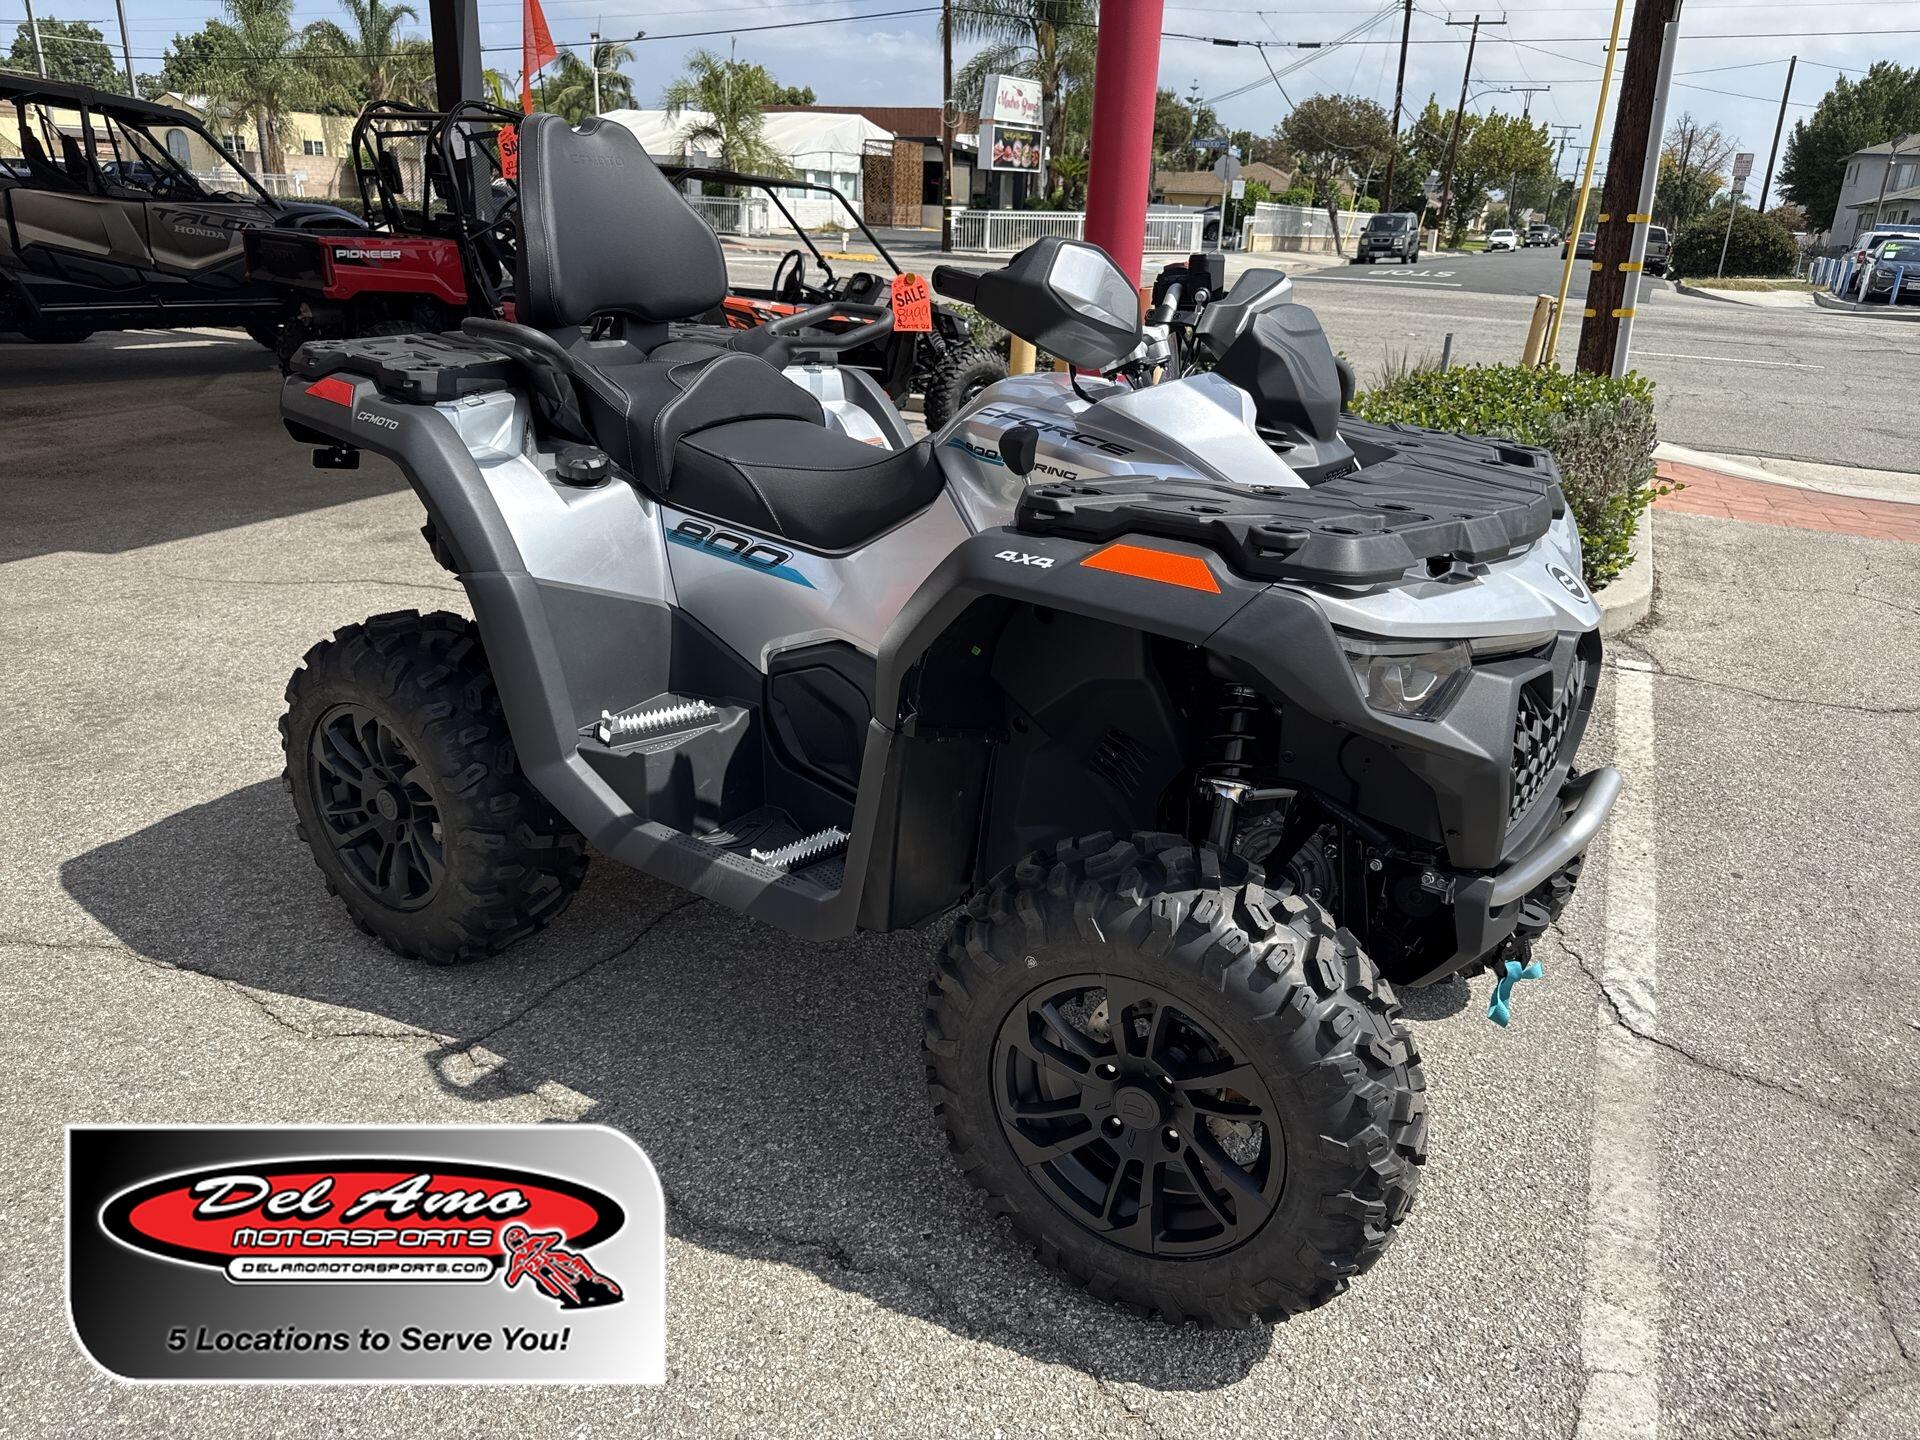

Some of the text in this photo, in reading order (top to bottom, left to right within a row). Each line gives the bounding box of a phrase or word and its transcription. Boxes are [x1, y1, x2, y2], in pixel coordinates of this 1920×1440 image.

[502, 140, 518, 157] SA
[174, 225, 228, 240] HONDA
[335, 249, 402, 260] PIONEER
[1368, 268, 1456, 278] STOP
[894, 285, 926, 308] SALE
[356, 410, 400, 431] CFMOTO
[976, 406, 1136, 457] CFORCE
[965, 441, 998, 460] 800
[671, 517, 795, 571] 800
